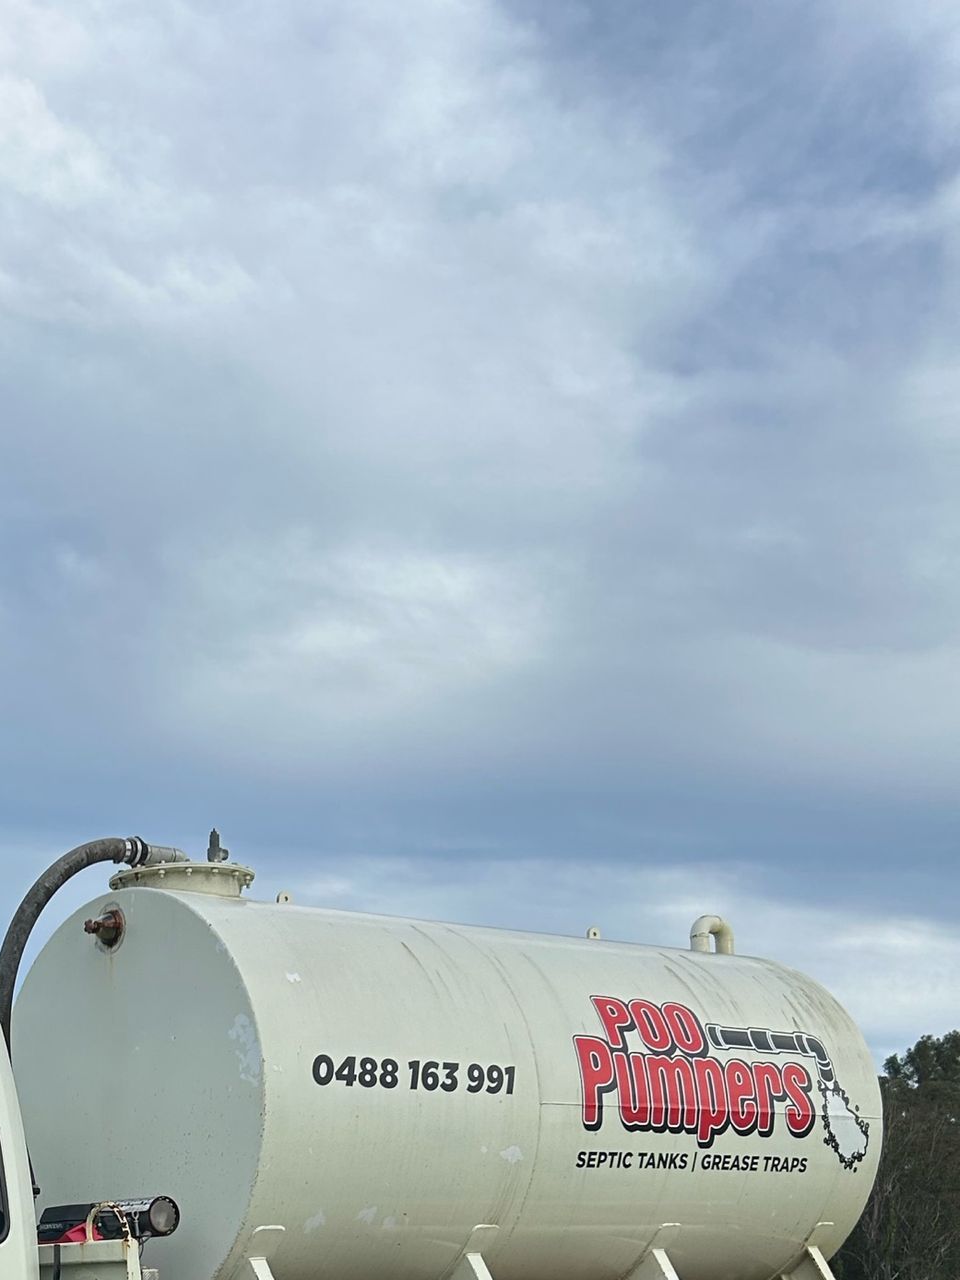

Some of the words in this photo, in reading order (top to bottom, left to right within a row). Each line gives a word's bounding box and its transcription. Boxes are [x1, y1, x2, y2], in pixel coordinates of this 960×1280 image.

[589, 995, 709, 1057] POO
[312, 1054, 399, 1089] 0488
[408, 1060, 459, 1092] 163
[466, 1063, 515, 1095] 991
[573, 1035, 815, 1149] Pumpers
[575, 1151, 633, 1169] SEPTIC
[638, 1153, 688, 1170] TANKS
[701, 1154, 759, 1172] GREASE
[763, 1156, 808, 1173] TRAPS
